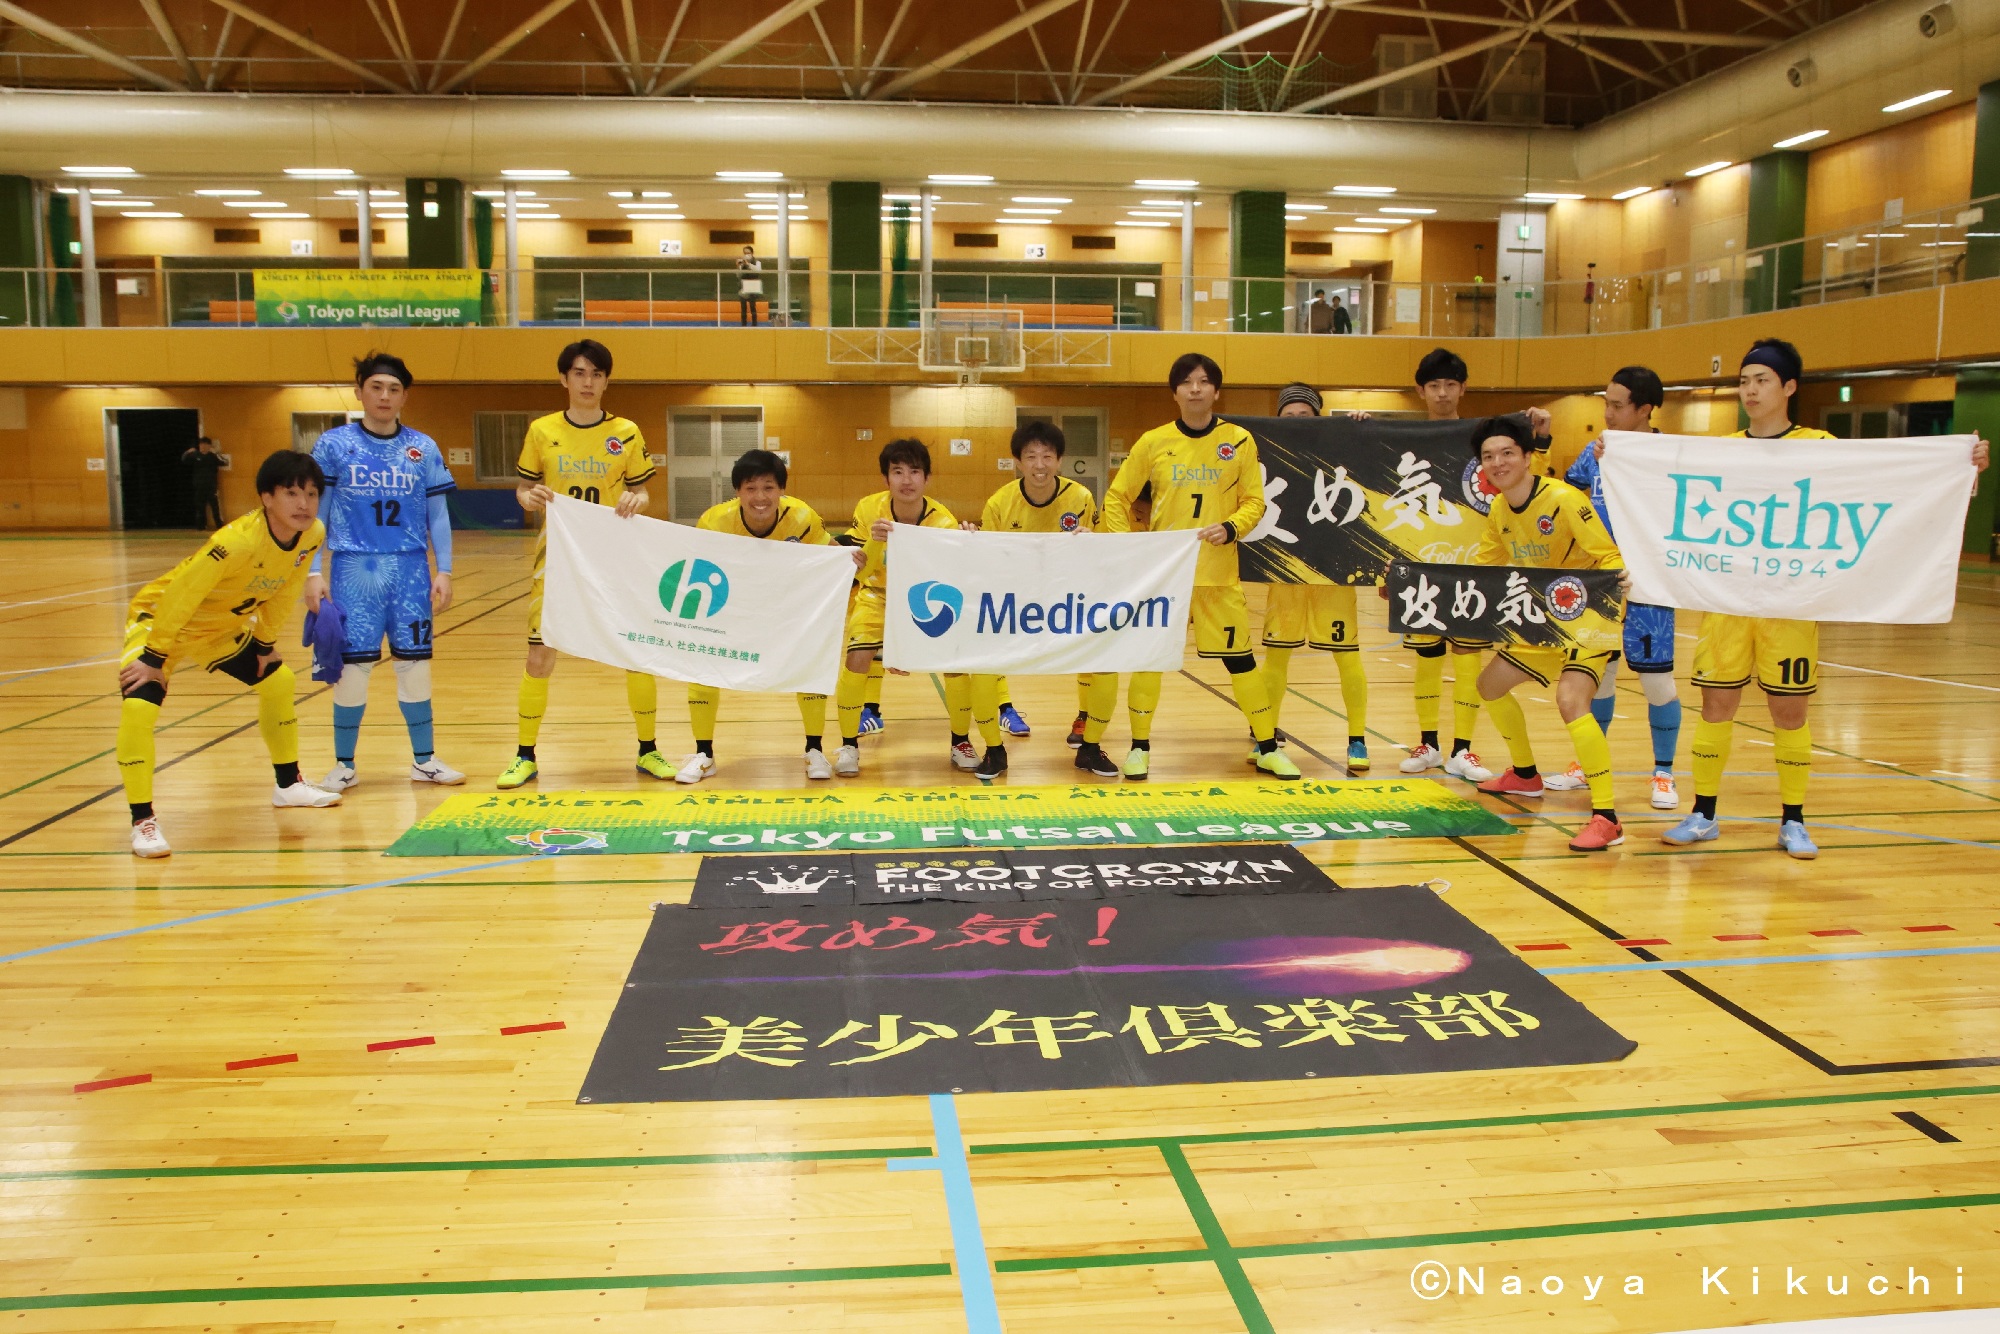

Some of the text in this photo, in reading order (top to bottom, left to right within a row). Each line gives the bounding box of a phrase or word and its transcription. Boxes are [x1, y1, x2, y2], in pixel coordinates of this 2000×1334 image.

[661, 242, 669, 253] 2
[1036, 246, 1044, 258] 3
[307, 303, 461, 322] Tokyo Futsal League
[557, 455, 612, 475] Esthy
[1073, 460, 1086, 474] C
[1171, 463, 1223, 485] Esthy
[348, 464, 419, 495] Esthy
[351, 488, 405, 497] SINCE 1994
[371, 500, 401, 527] 12
[1191, 494, 1203, 518] 7
[1663, 473, 1893, 570] Esthy
[1665, 549, 1827, 578] SINCE 1994
[1398, 570, 1547, 631] 攻め気
[408, 619, 433, 645] 12
[1223, 626, 1236, 648] 7
[1331, 621, 1345, 642] 3
[1639, 634, 1653, 658] 1
[1777, 657, 1810, 685] 10
[675, 795, 845, 806] ATHLETA
[874, 792, 1041, 803] ATHLETA
[662, 819, 1412, 849] Tokyo Futsal League
[875, 859, 1295, 884] FOOTCROWN
[878, 873, 1283, 893] THE KING OF FOOTBALL
[657, 990, 1541, 1072] 美少年倶楽部
